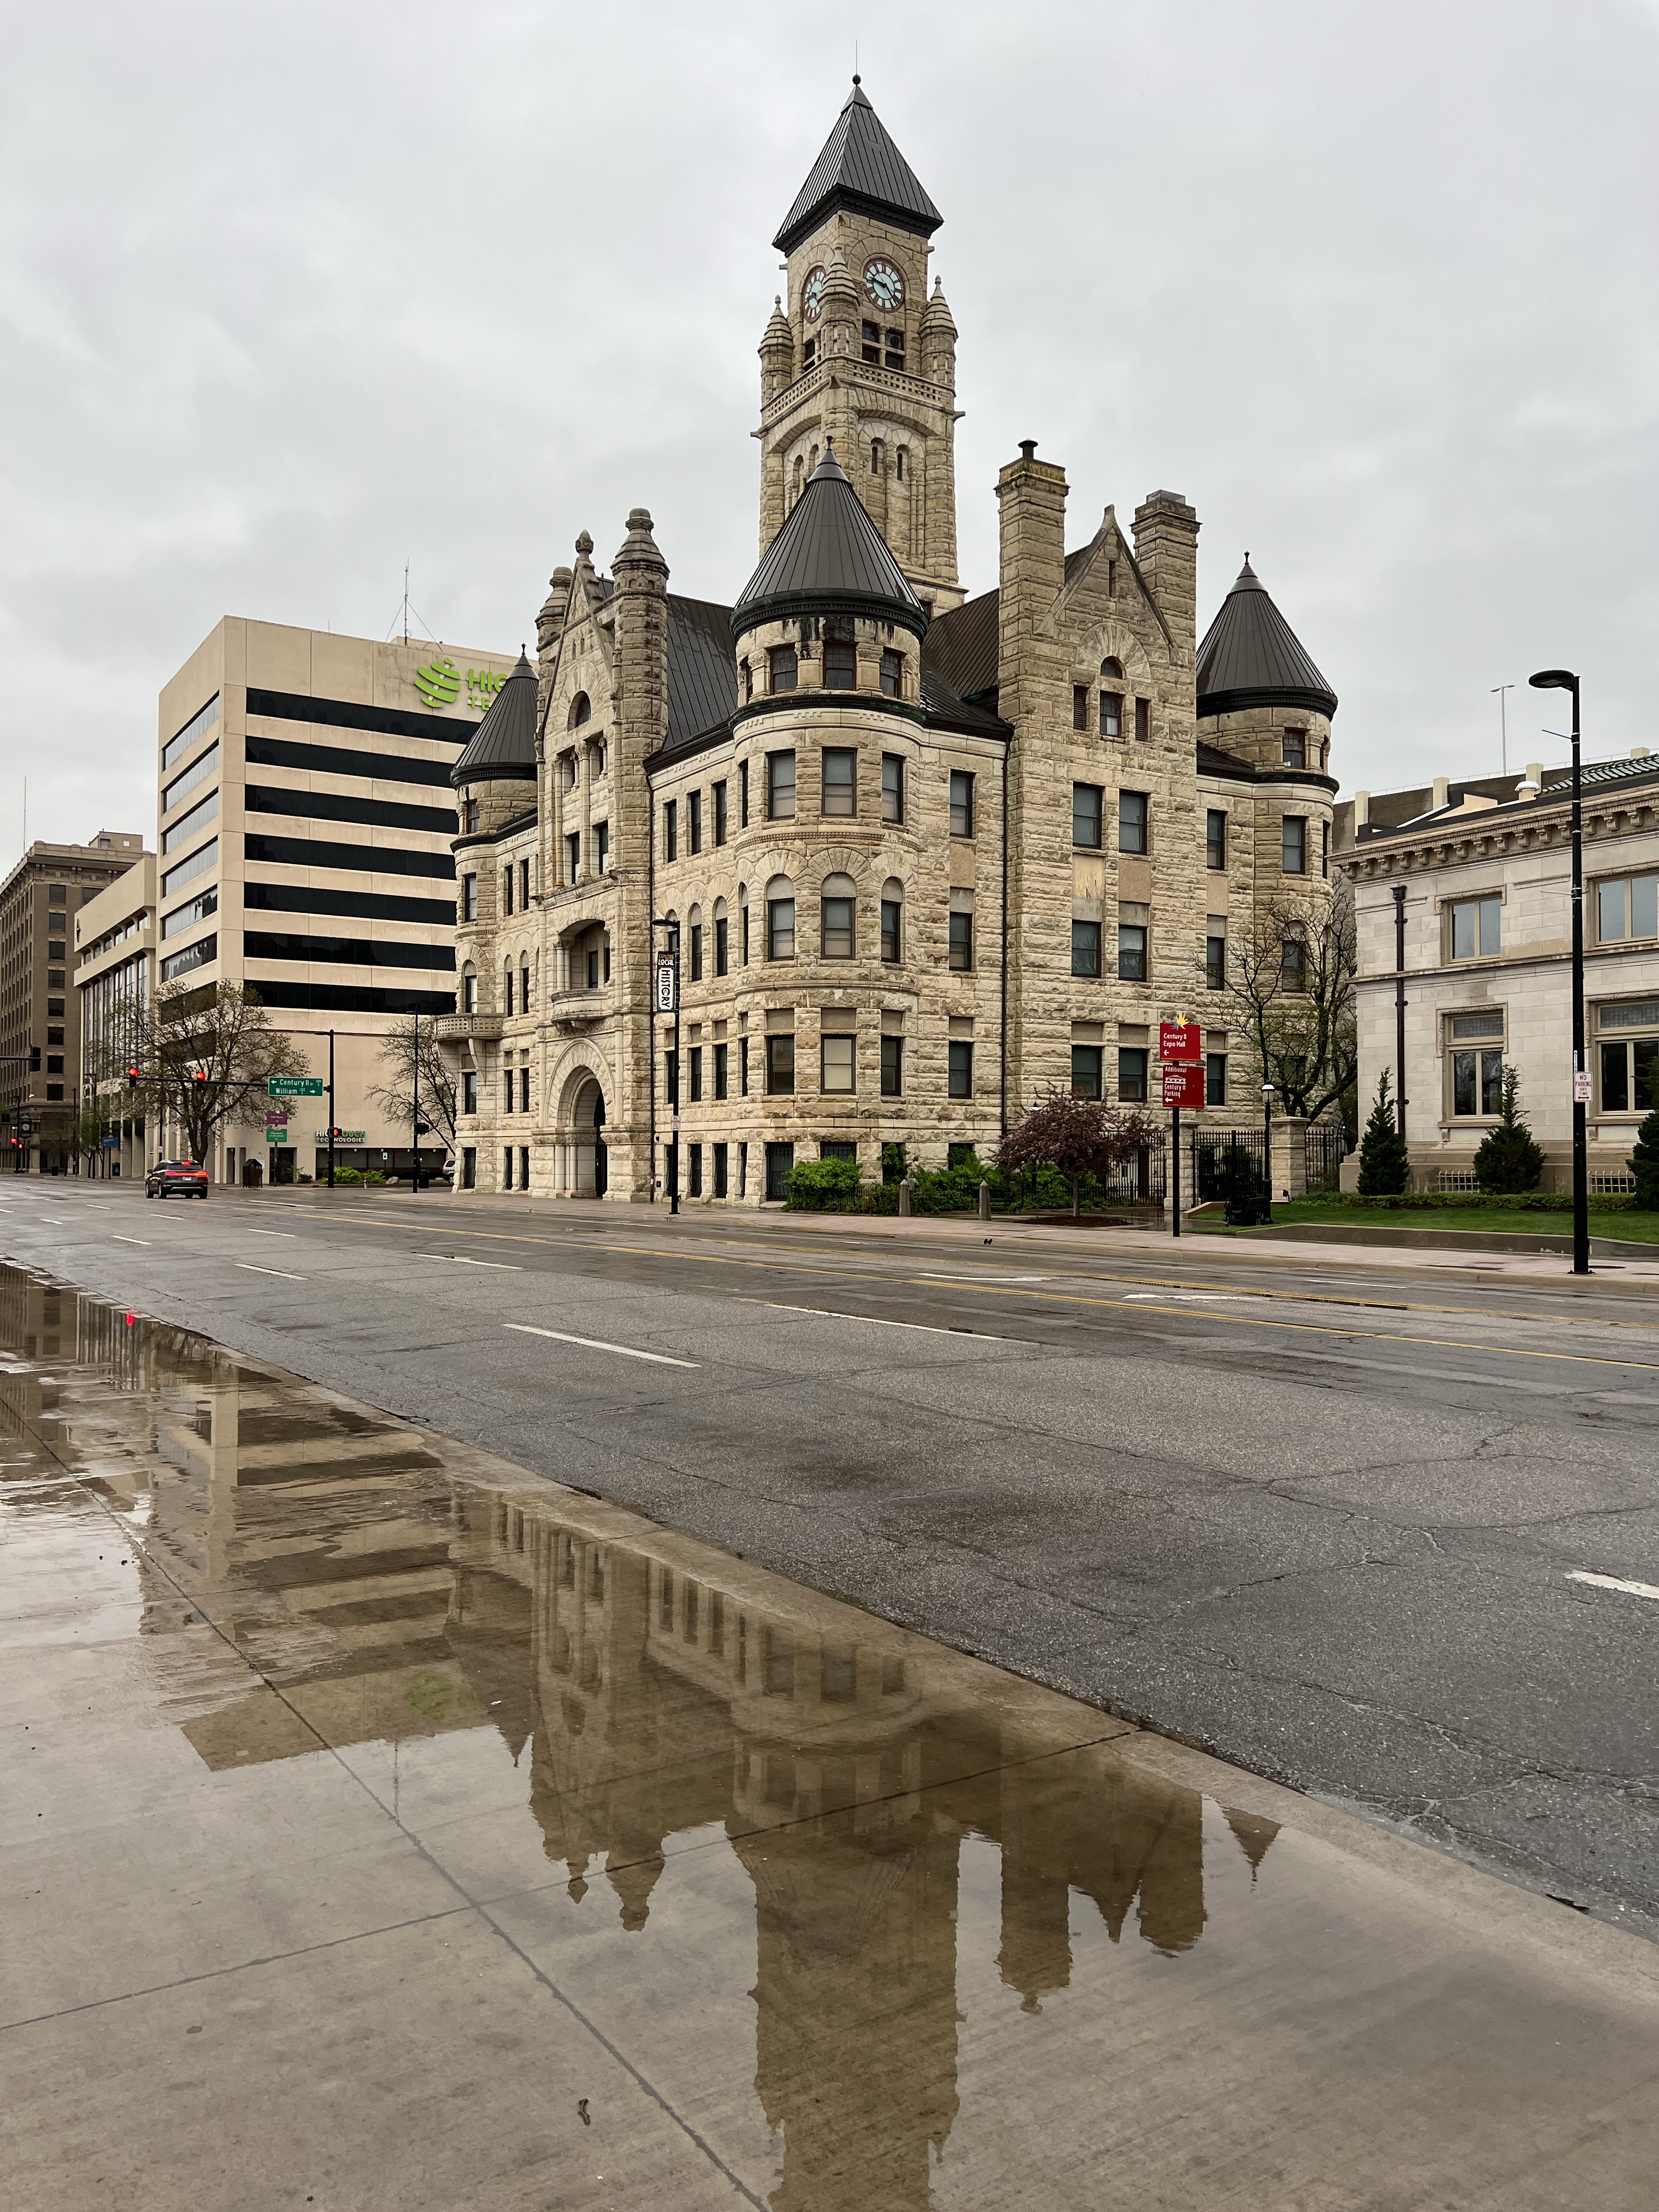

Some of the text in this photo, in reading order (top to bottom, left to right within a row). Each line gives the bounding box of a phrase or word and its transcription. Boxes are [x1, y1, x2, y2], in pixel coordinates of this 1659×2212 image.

[661, 969, 670, 1008] HISTORY
[279, 1079, 304, 1087] Century
[1164, 1084, 1182, 1092] Century
